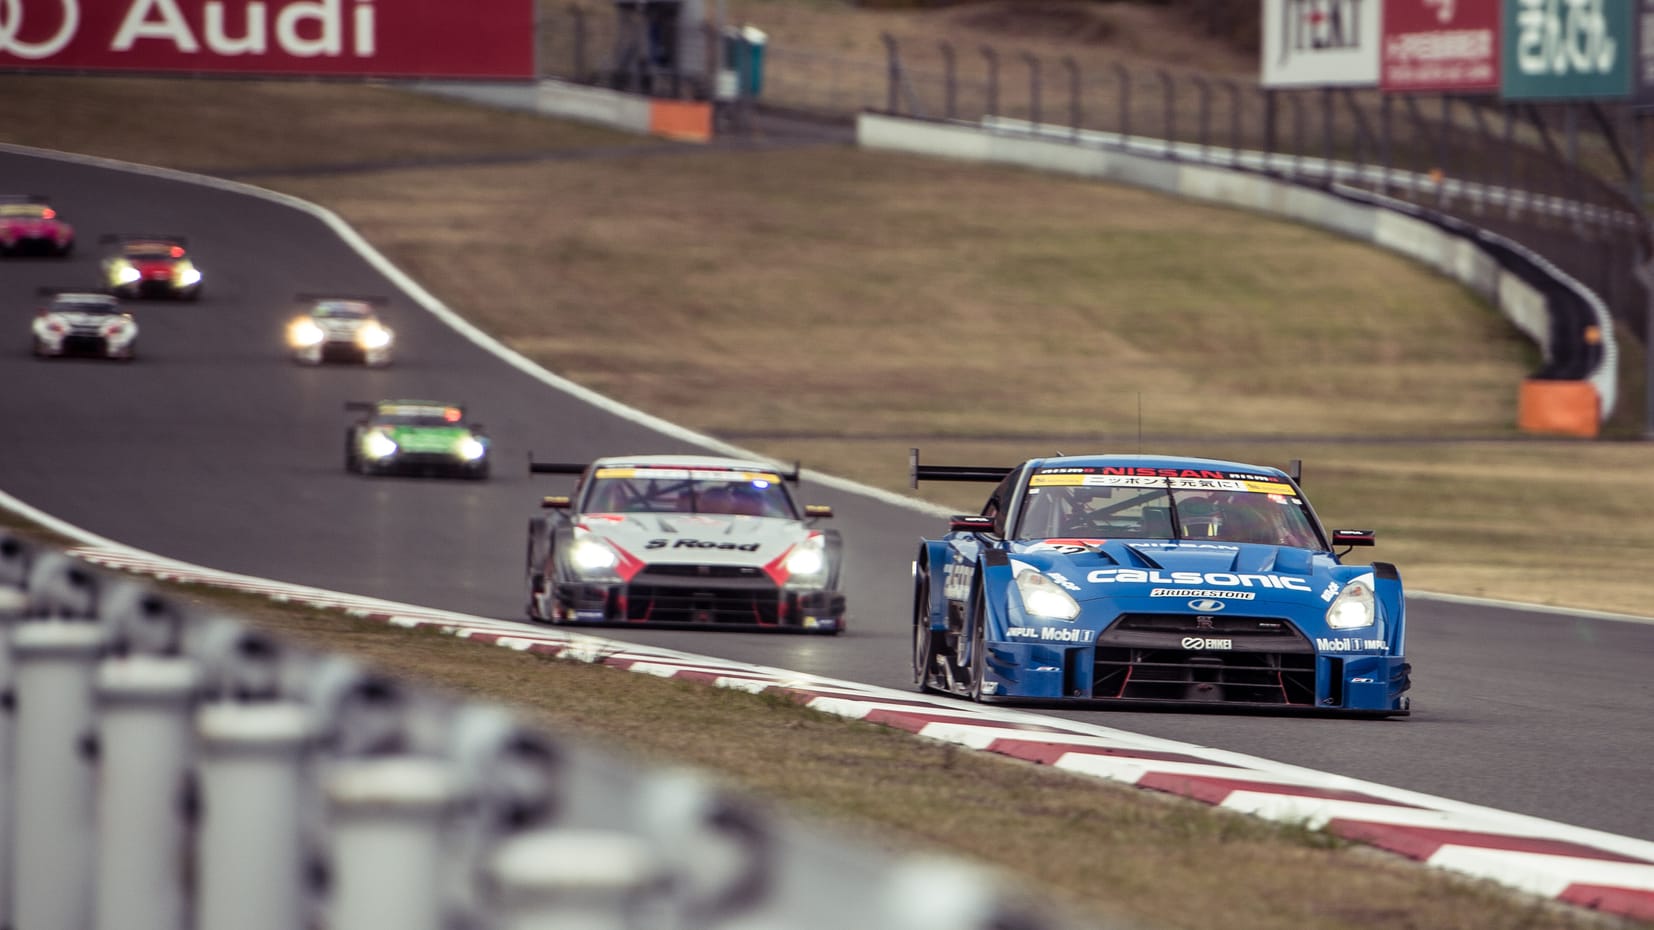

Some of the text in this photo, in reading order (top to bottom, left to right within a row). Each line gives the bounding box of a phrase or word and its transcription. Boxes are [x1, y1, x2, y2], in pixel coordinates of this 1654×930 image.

[110, 0, 375, 57] Audi
[1102, 467, 1224, 479] NISSAN
[645, 538, 760, 552] S Road
[1127, 542, 1240, 550] NISSAN
[1153, 589, 1252, 599] BRIDGESTONE
[1041, 627, 1079, 642] Mobil
[1316, 637, 1351, 651] Mobil
